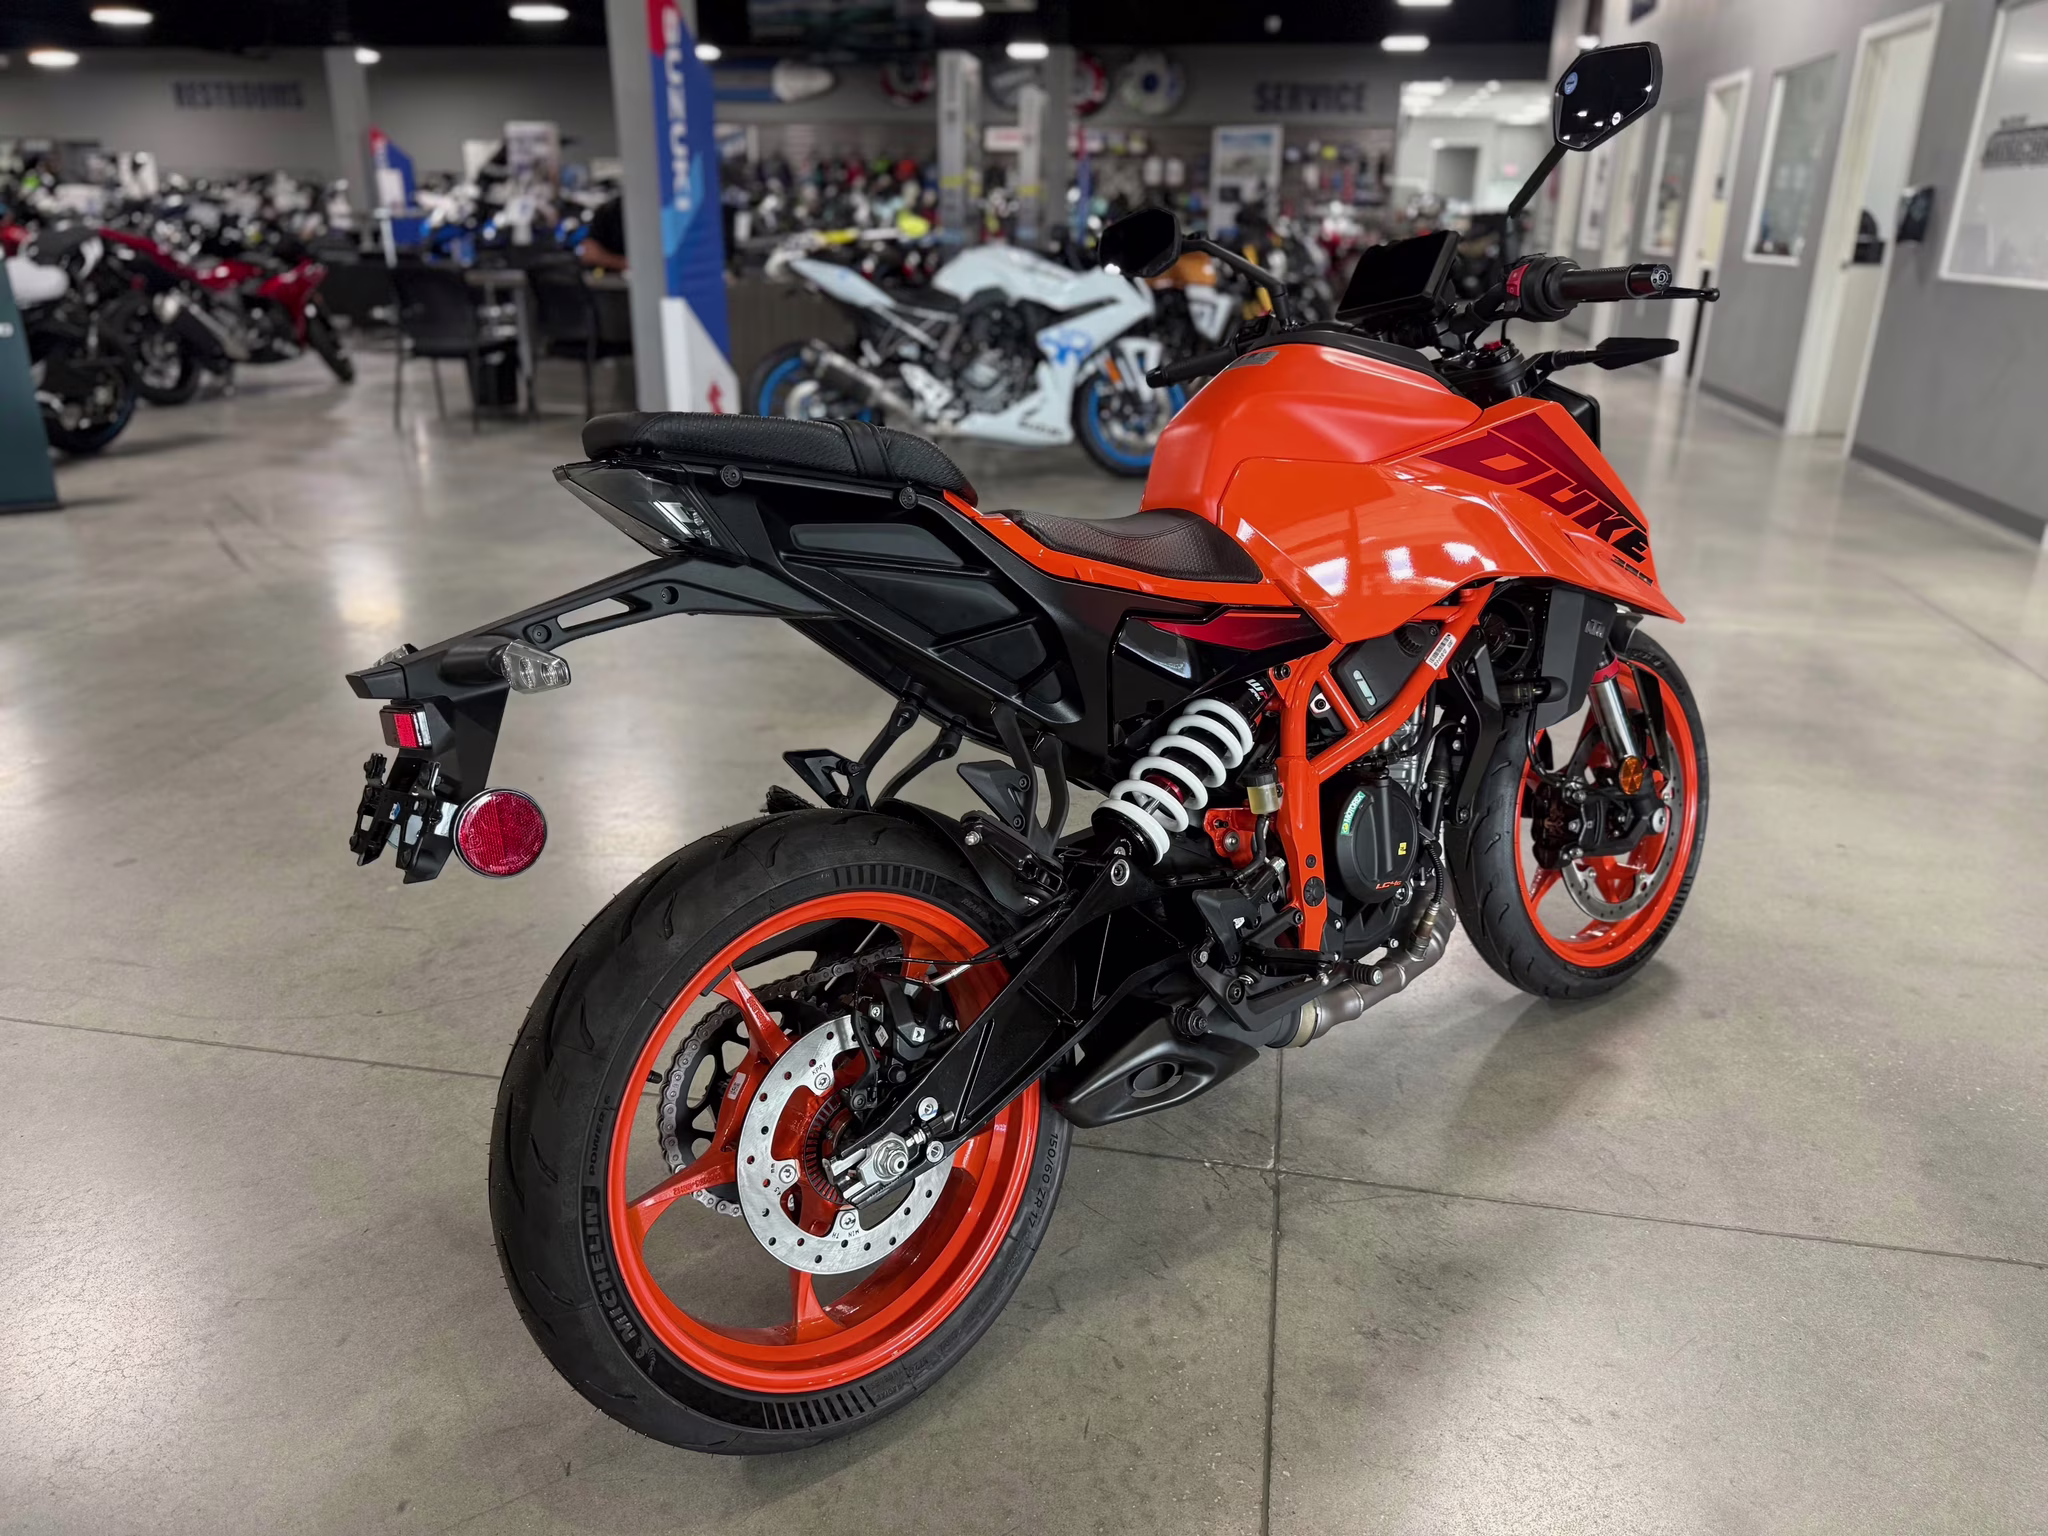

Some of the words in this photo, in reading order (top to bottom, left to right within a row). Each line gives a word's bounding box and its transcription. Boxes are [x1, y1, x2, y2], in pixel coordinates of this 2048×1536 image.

[661, 5, 691, 212] SUZUKI
[1254, 81, 1366, 113] SERVICE
[1418, 430, 1649, 564] DUKE
[1343, 791, 1365, 824] MOTOREX
[588, 1110, 607, 1177] POWER
[1042, 1133, 1059, 1184] 150/60
[1029, 1210, 1039, 1229] 17
[1034, 1187, 1047, 1209] ZR
[584, 1185, 637, 1342] MICHELIN
